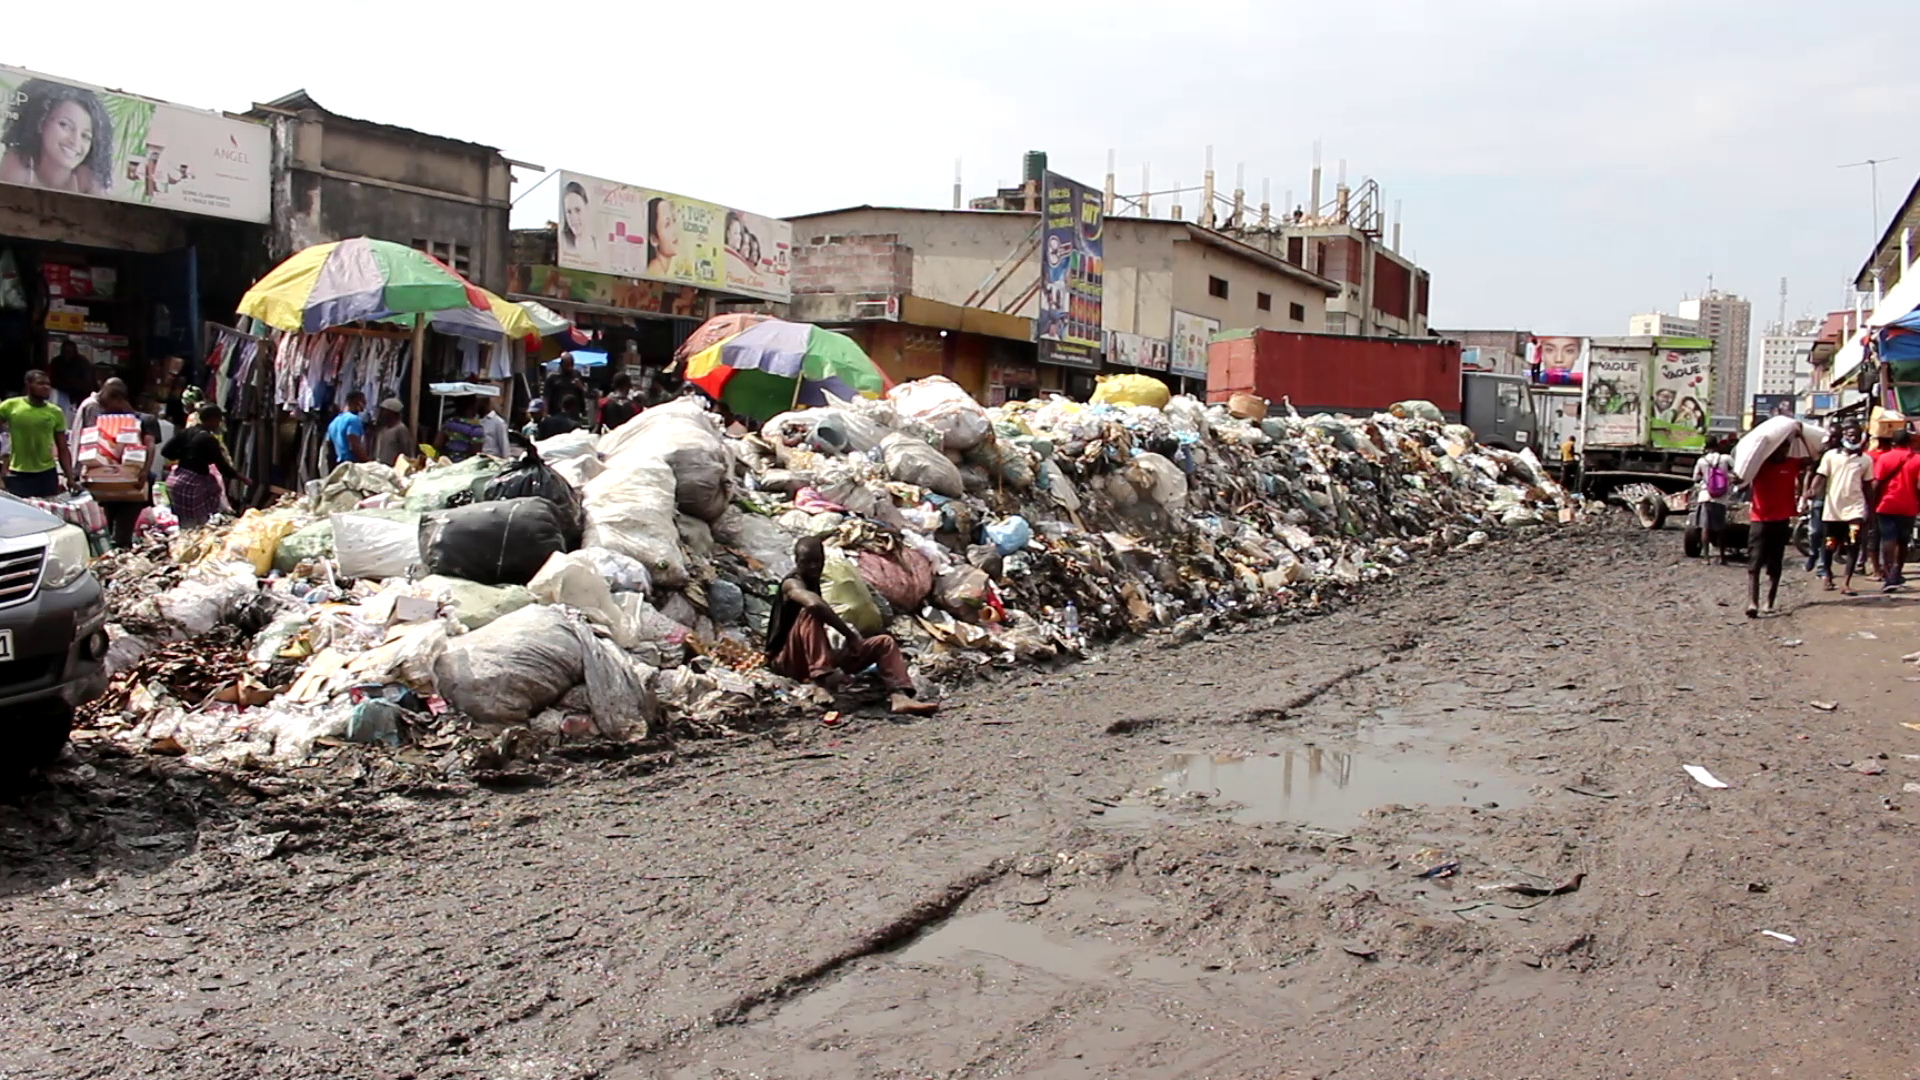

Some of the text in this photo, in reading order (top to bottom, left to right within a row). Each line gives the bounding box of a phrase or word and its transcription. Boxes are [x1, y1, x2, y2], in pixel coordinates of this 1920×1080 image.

[213, 146, 250, 164] ANGEL
[687, 205, 706, 223] TOP
[1662, 364, 1701, 379] VAGUE
